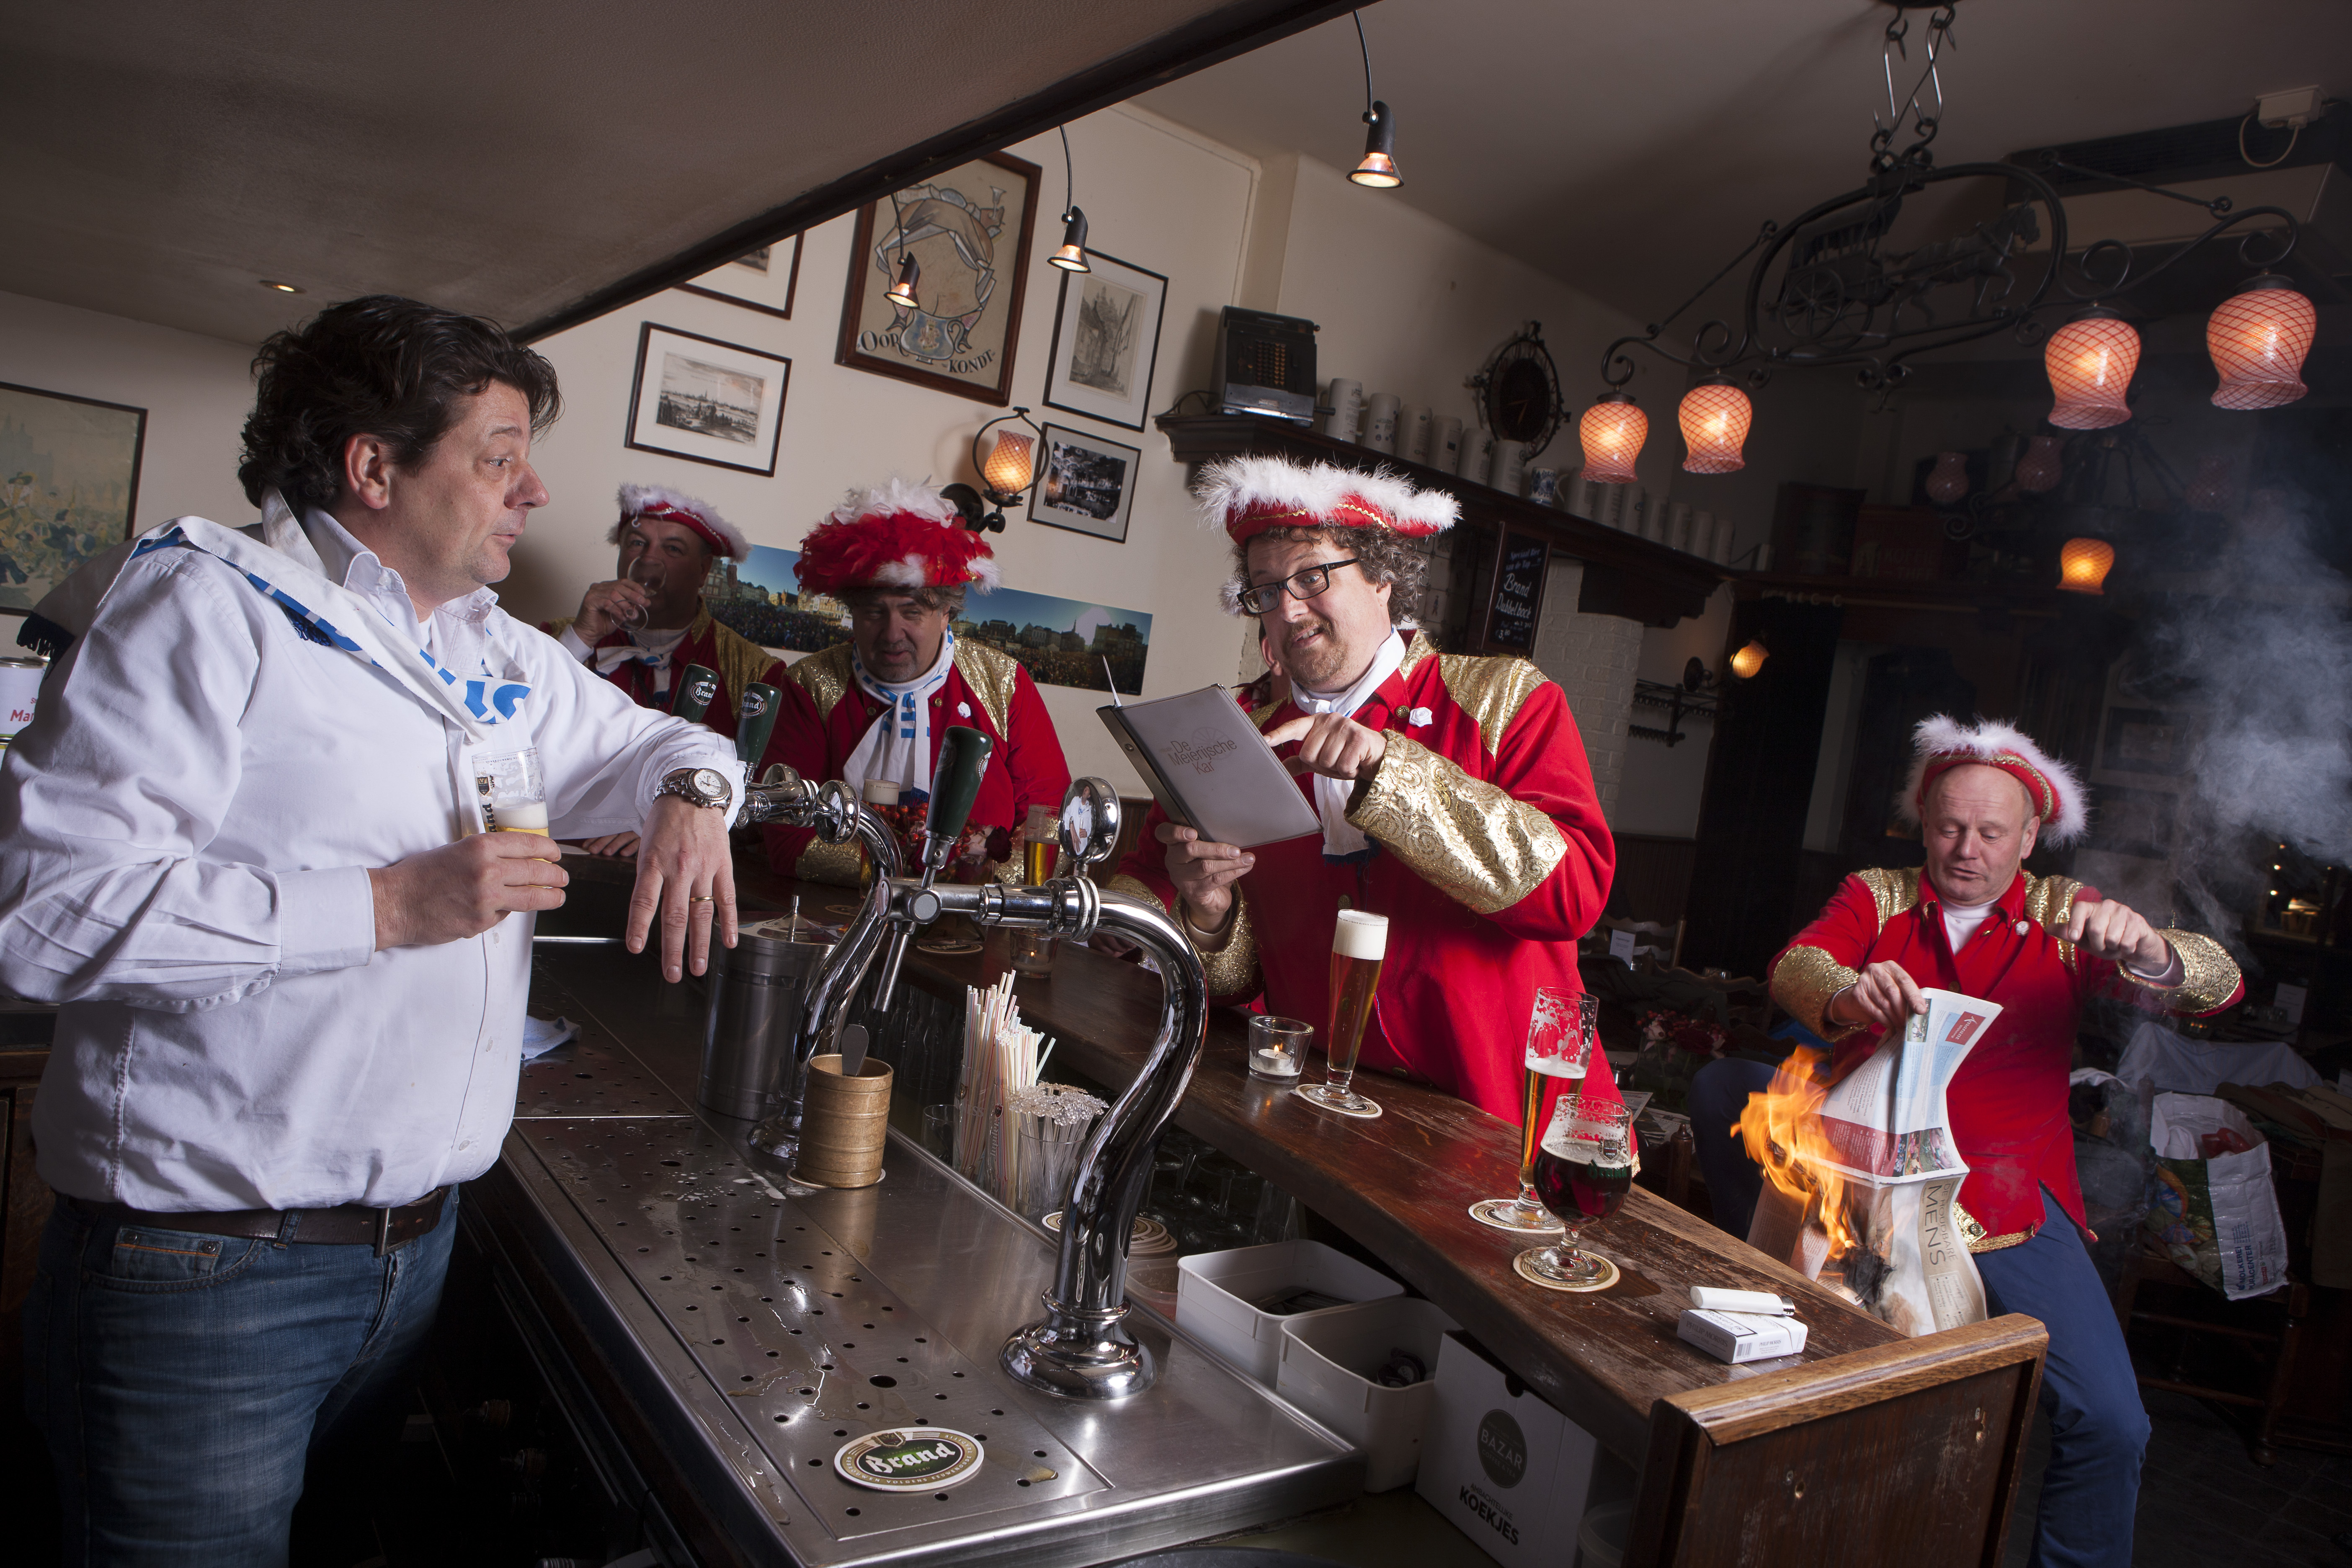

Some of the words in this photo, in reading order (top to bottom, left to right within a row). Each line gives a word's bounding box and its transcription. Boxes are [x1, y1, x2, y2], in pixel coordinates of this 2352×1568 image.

[1504, 573, 1532, 598] Brand
[1168, 740, 1237, 766] Meierijsche
[1170, 740, 1191, 753] De
[1192, 761, 1215, 775] Kar
[1955, 1016, 1978, 1039] Amarant
[989, 1119, 1000, 1162] Jupiler
[1942, 1183, 1952, 1196] DE
[1925, 1185, 1946, 1265] MENS
[1939, 1199, 1959, 1262] HOUDBARE
[2235, 1247, 2246, 1282] MOLKEREI
[2245, 1245, 2256, 1290] PURACENTER
[1686, 1320, 1705, 1336] PHILIP
[1705, 1331, 1728, 1347] MORRIS
[865, 1442, 955, 1474] Brand
[944, 1434, 973, 1454] TRADITIE
[1481, 1428, 1523, 1472] BAZAR
[846, 1456, 880, 1483] GEBROUWEN
[931, 1455, 972, 1480] EEUWENOUDE
[1483, 1449, 1501, 1469] COFFEE
[1506, 1466, 1516, 1478] TEA
[1459, 1485, 1520, 1545] KOEKJES
[1470, 1483, 1513, 1521] AMBACHTELIJKE
